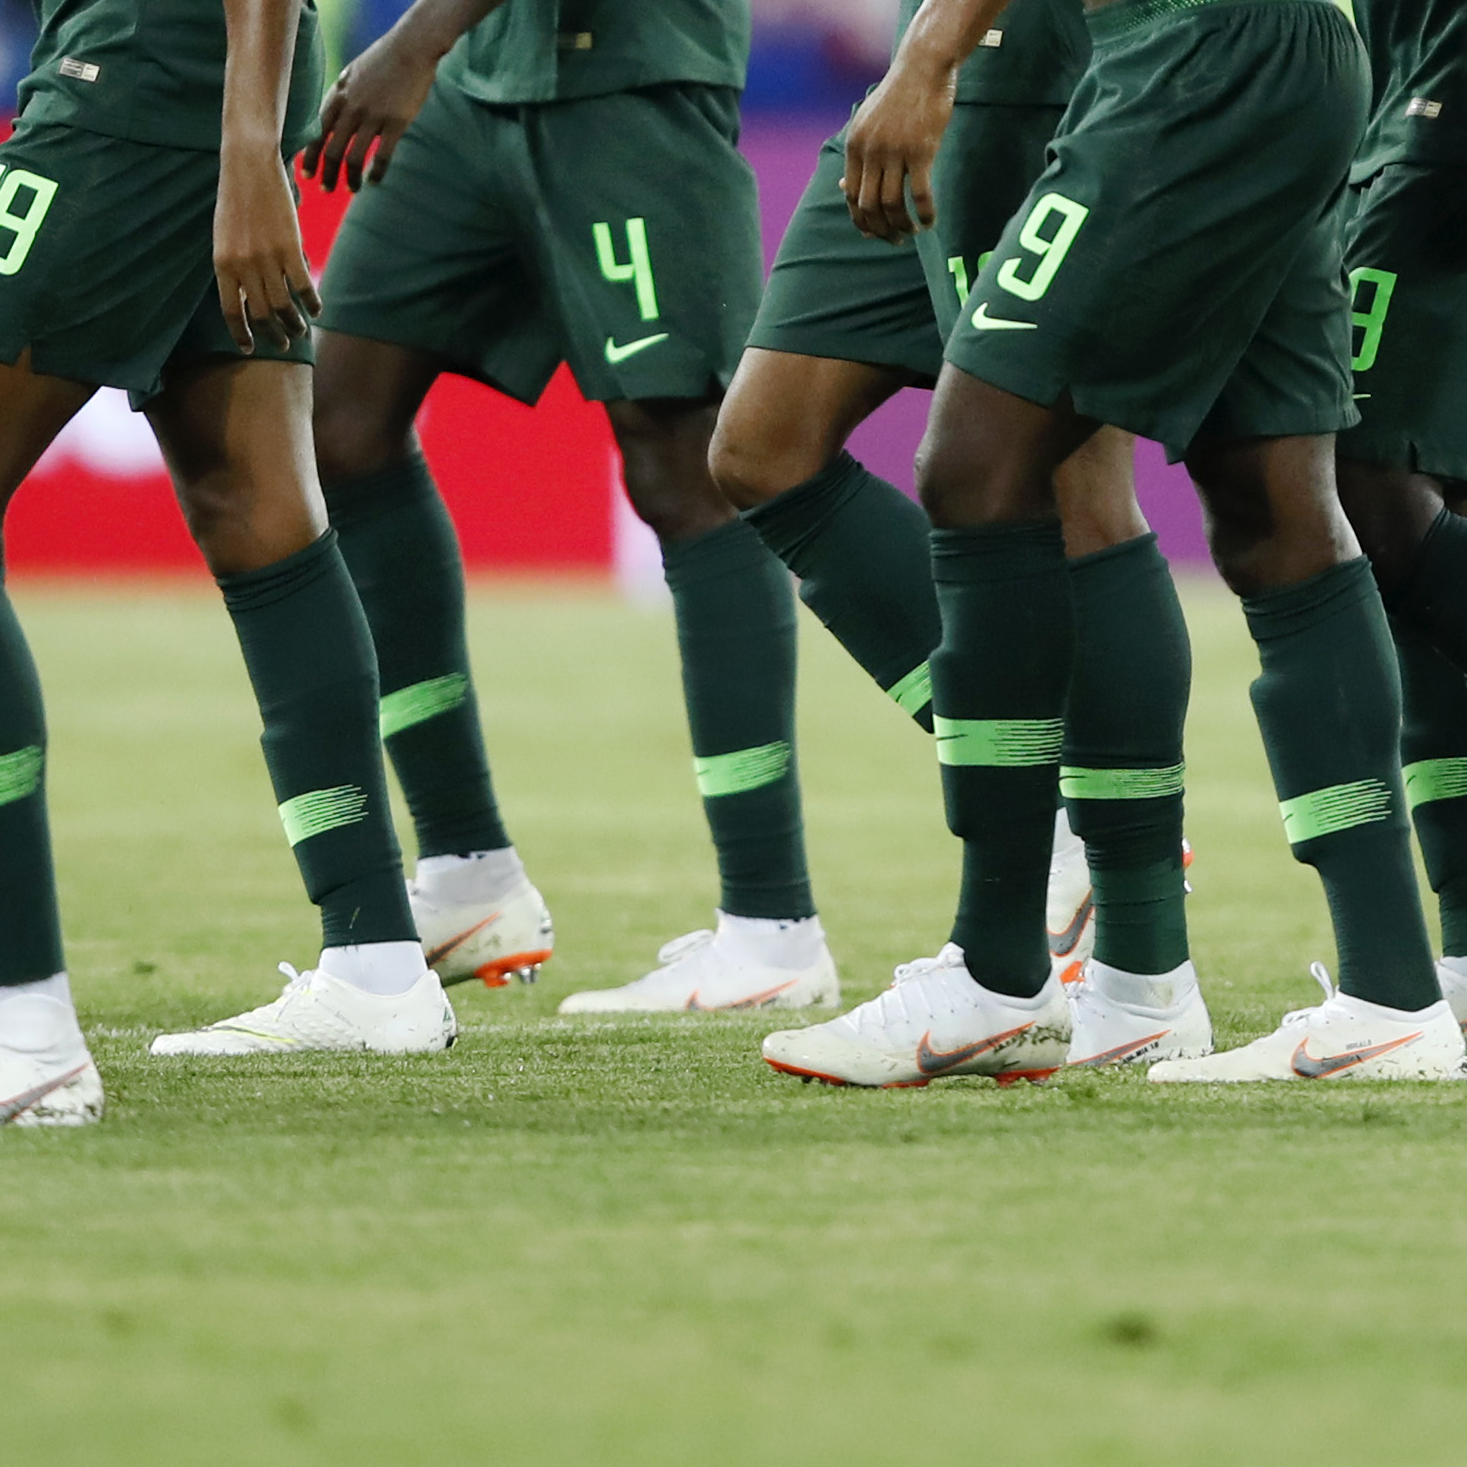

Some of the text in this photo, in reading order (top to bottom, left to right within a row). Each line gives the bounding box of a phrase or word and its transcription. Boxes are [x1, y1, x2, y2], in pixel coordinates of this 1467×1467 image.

[591, 217, 660, 321] 4
[947, 250, 995, 310] 1
[996, 191, 1091, 302] 9
